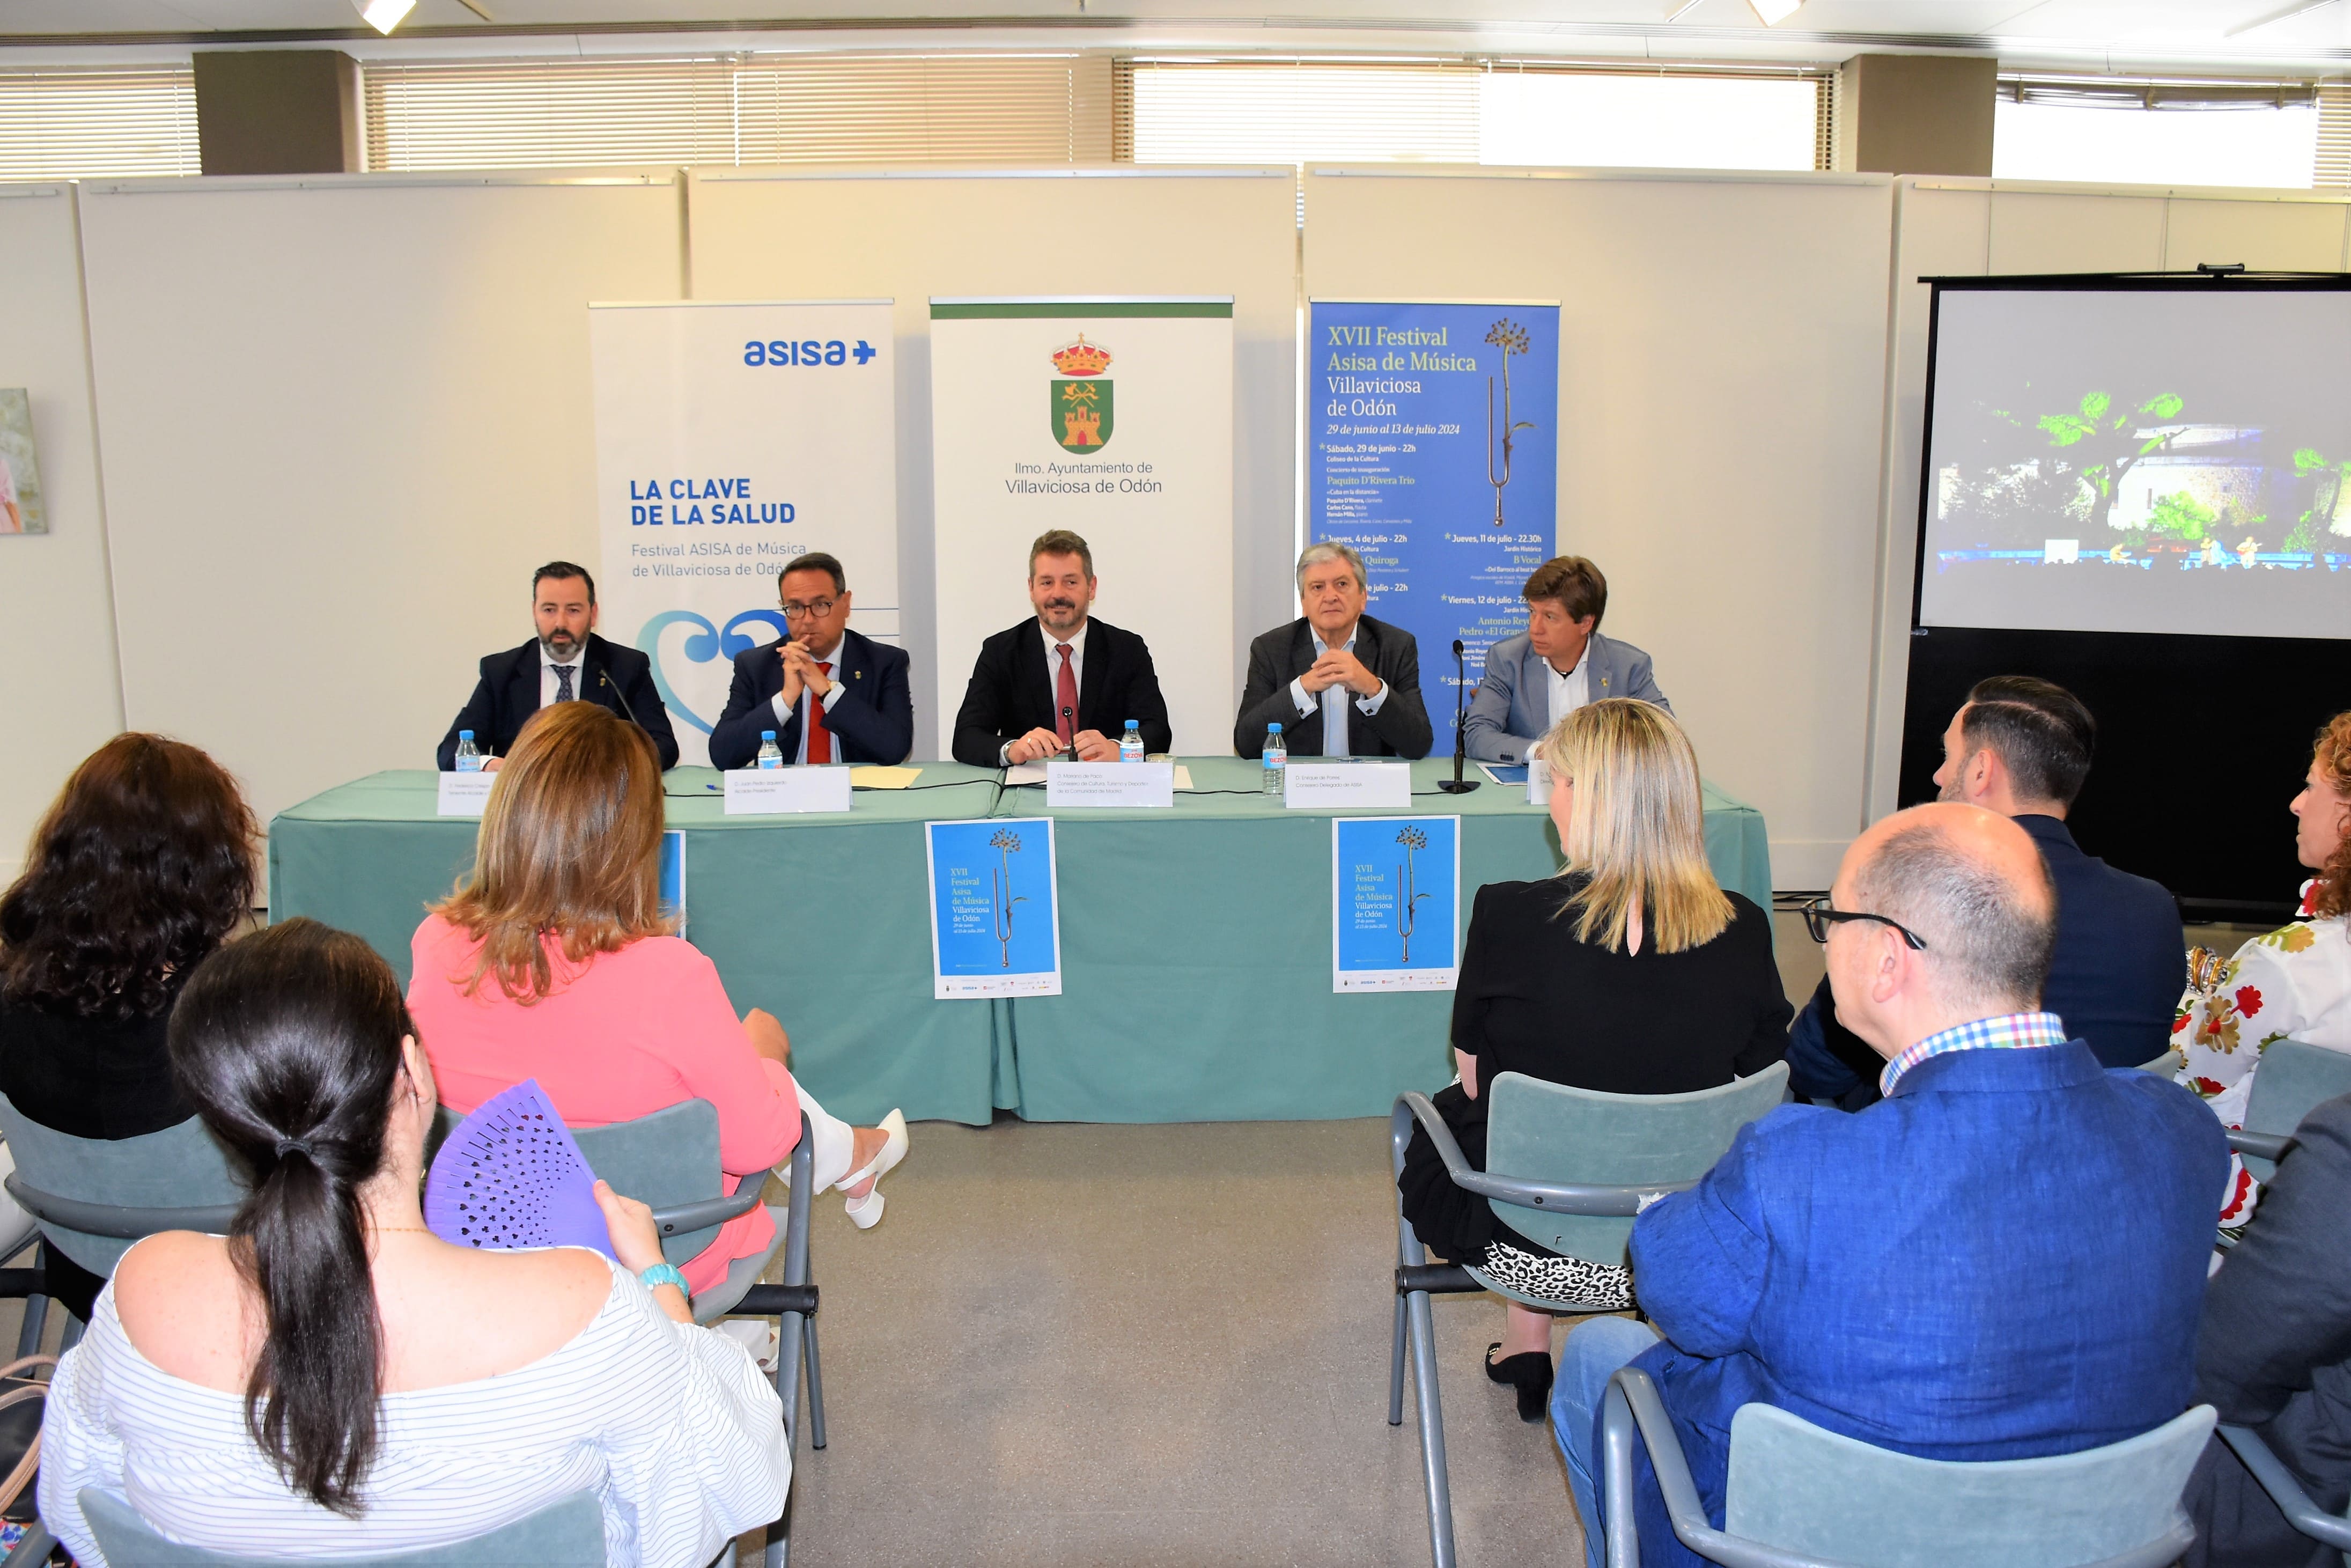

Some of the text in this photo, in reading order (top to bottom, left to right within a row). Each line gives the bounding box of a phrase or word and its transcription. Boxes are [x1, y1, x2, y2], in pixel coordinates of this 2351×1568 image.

[1328, 326, 1448, 346] XVII Festival
[744, 340, 846, 366] asisa
[1327, 351, 1477, 371] Asisa de Música
[1327, 376, 1421, 394] Villaviciosa
[1327, 399, 1397, 417] de Odón
[1327, 424, 1460, 436] 29 de junio al 13 de julio 2024
[1326, 444, 1416, 454] Sábado, 29 de junio 22h
[1015, 462, 1153, 476] Ilmo. Ayuntamiento de
[1005, 478, 1162, 494] Villaviciosa de Odón
[1327, 476, 1360, 487] Paquito
[630, 479, 750, 500] LA CLAVE
[631, 504, 795, 526] DE LA SALUD
[1355, 535, 1361, 543] 4
[1362, 535, 1371, 543] de
[1372, 535, 1388, 544] julio
[1394, 534, 1407, 542] 22h
[1451, 534, 1542, 544] Jueves, 11 de julio 22.30h
[632, 542, 806, 556] Festival ASISA de Música
[1365, 556, 1398, 566] Quiroga
[1514, 556, 1541, 564] B Vocal
[632, 562, 784, 577] de Villaviciosa de Odó
[1373, 584, 1389, 593] julio
[1448, 596, 1477, 605] Viernes,
[1486, 596, 1495, 604] de
[1496, 596, 1512, 605] julio
[1478, 617, 1511, 625] Antonio
[1459, 627, 1484, 636] Pedro
[1448, 678, 1475, 686] Sábdo,
[950, 868, 968, 876] XVII
[952, 877, 979, 886] Festival
[1355, 874, 1384, 882] Festival
